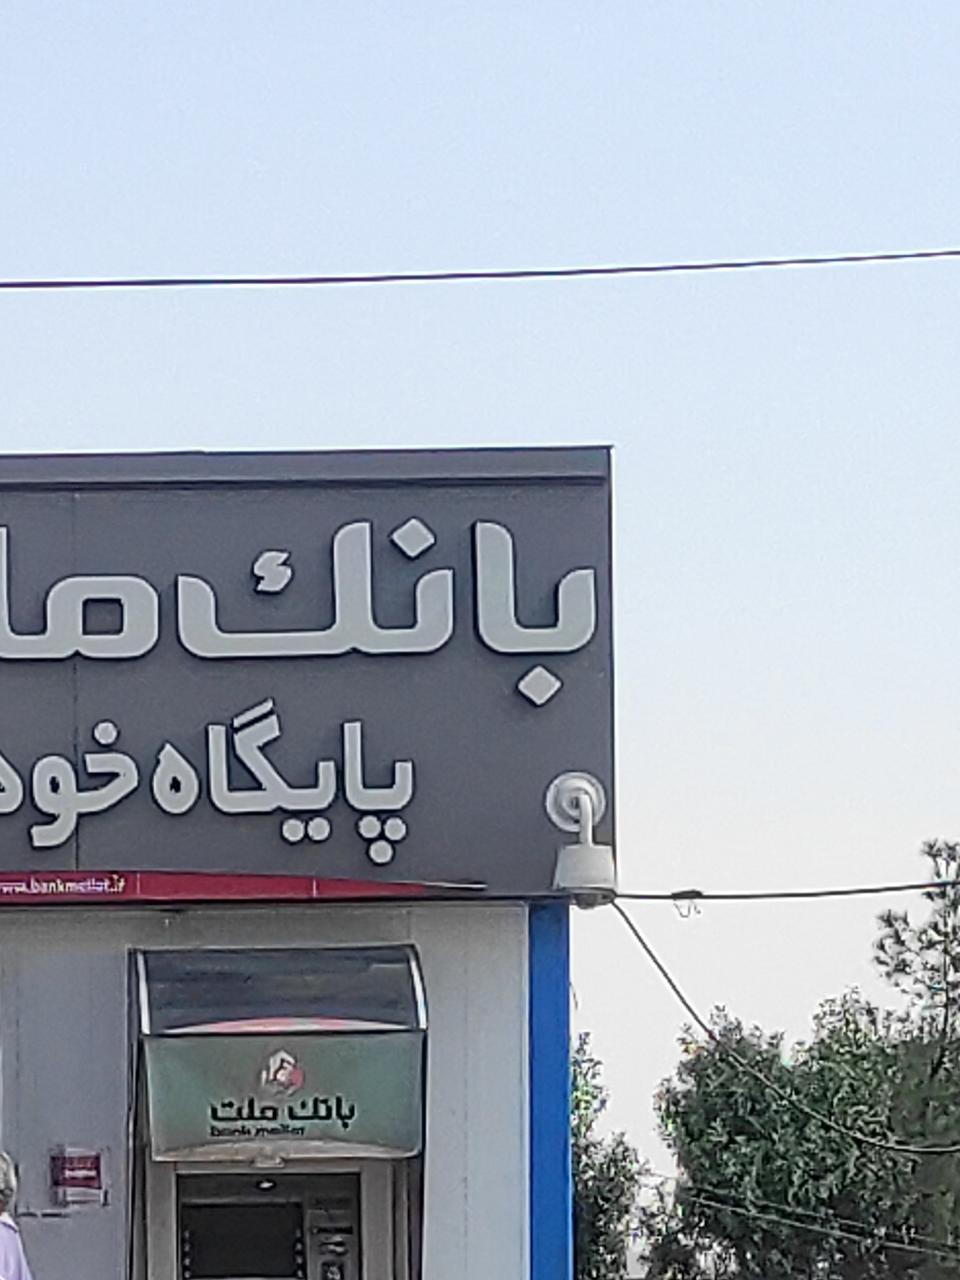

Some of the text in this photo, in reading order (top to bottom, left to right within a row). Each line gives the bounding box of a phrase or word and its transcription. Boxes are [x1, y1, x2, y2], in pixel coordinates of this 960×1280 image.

[177, 519, 596, 705] بانک
[152, 699, 414, 864] پایگاه
[210, 1096, 356, 1129] بانک ملت
